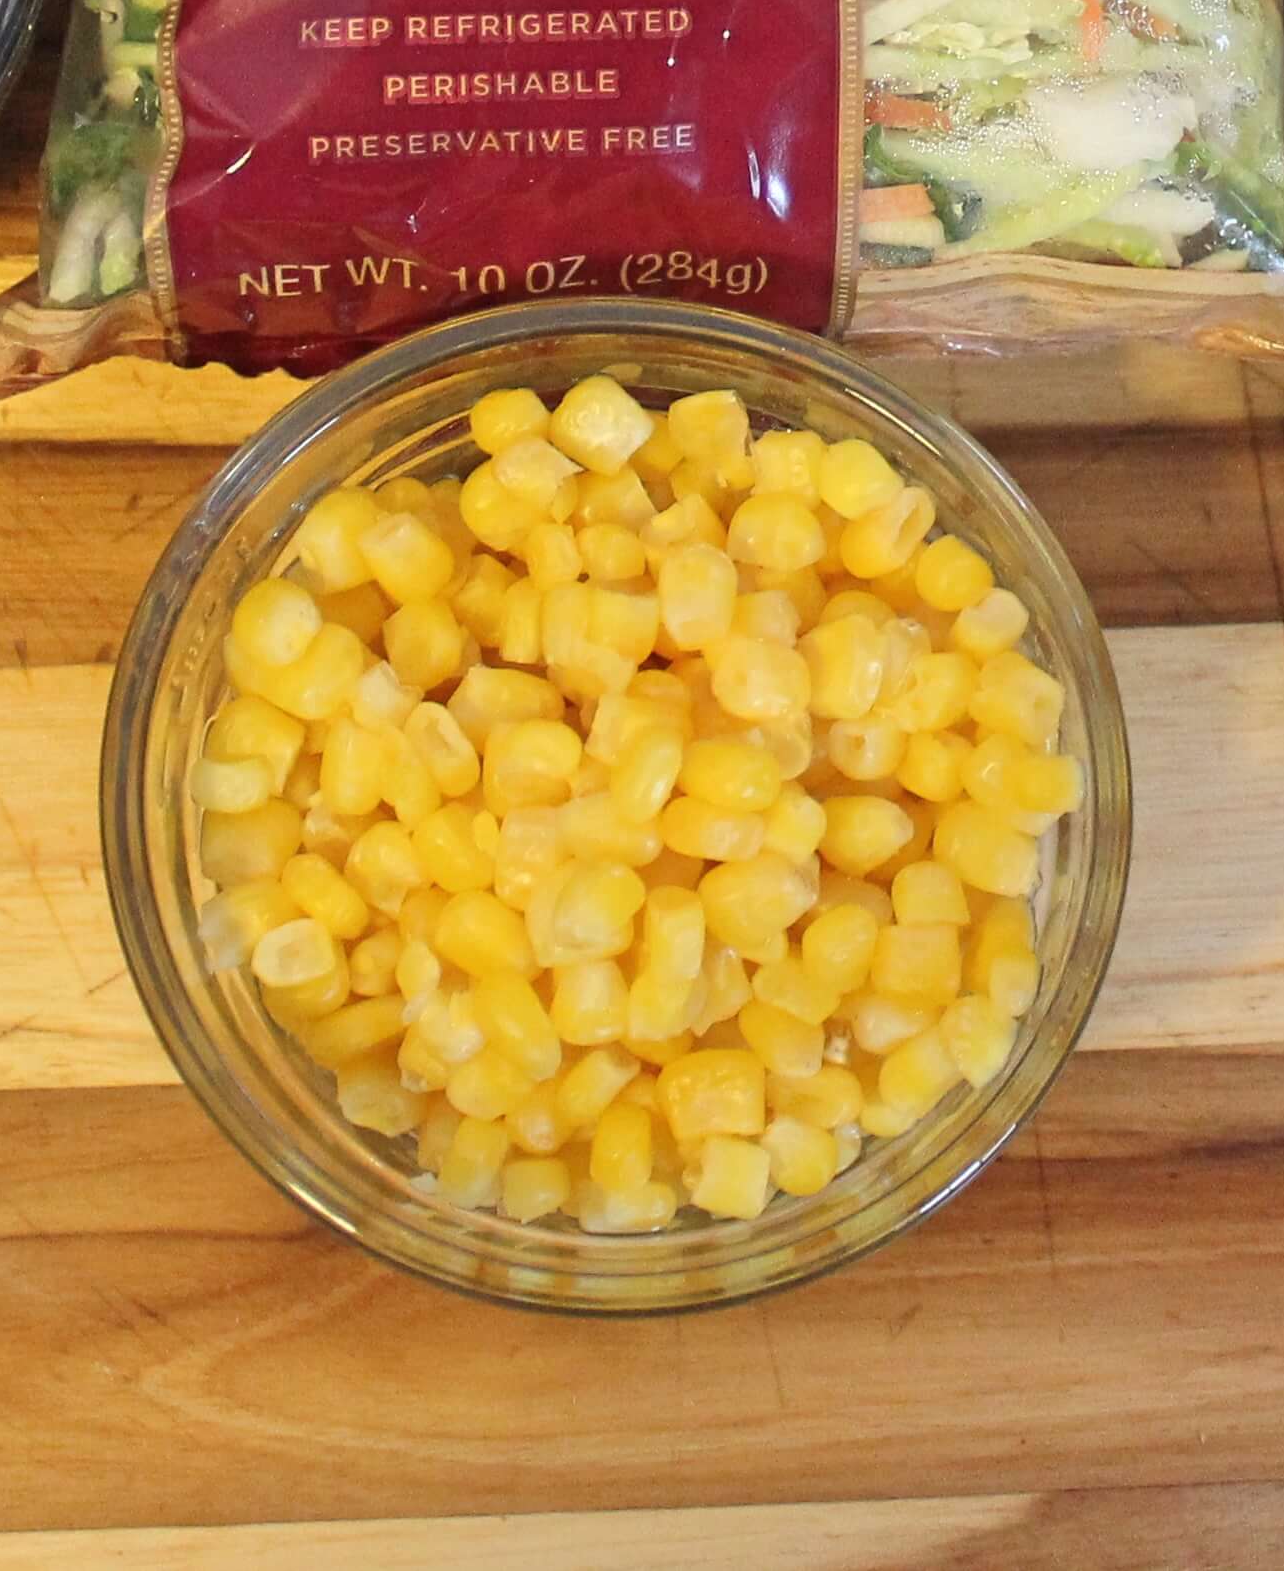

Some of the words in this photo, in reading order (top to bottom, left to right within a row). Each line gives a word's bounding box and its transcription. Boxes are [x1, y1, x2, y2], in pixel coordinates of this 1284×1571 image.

[301, 17, 390, 43] KEEP
[408, 10, 690, 41] REFRIGERATED
[386, 69, 618, 100] PERISHABLE
[310, 129, 586, 160] PRESERVATIVE
[603, 125, 694, 152] FREE
[239, 264, 330, 297] NET
[345, 256, 428, 292] WT.
[450, 264, 505, 292] 10
[526, 255, 598, 295] OZ.
[619, 250, 768, 295] (284g)
